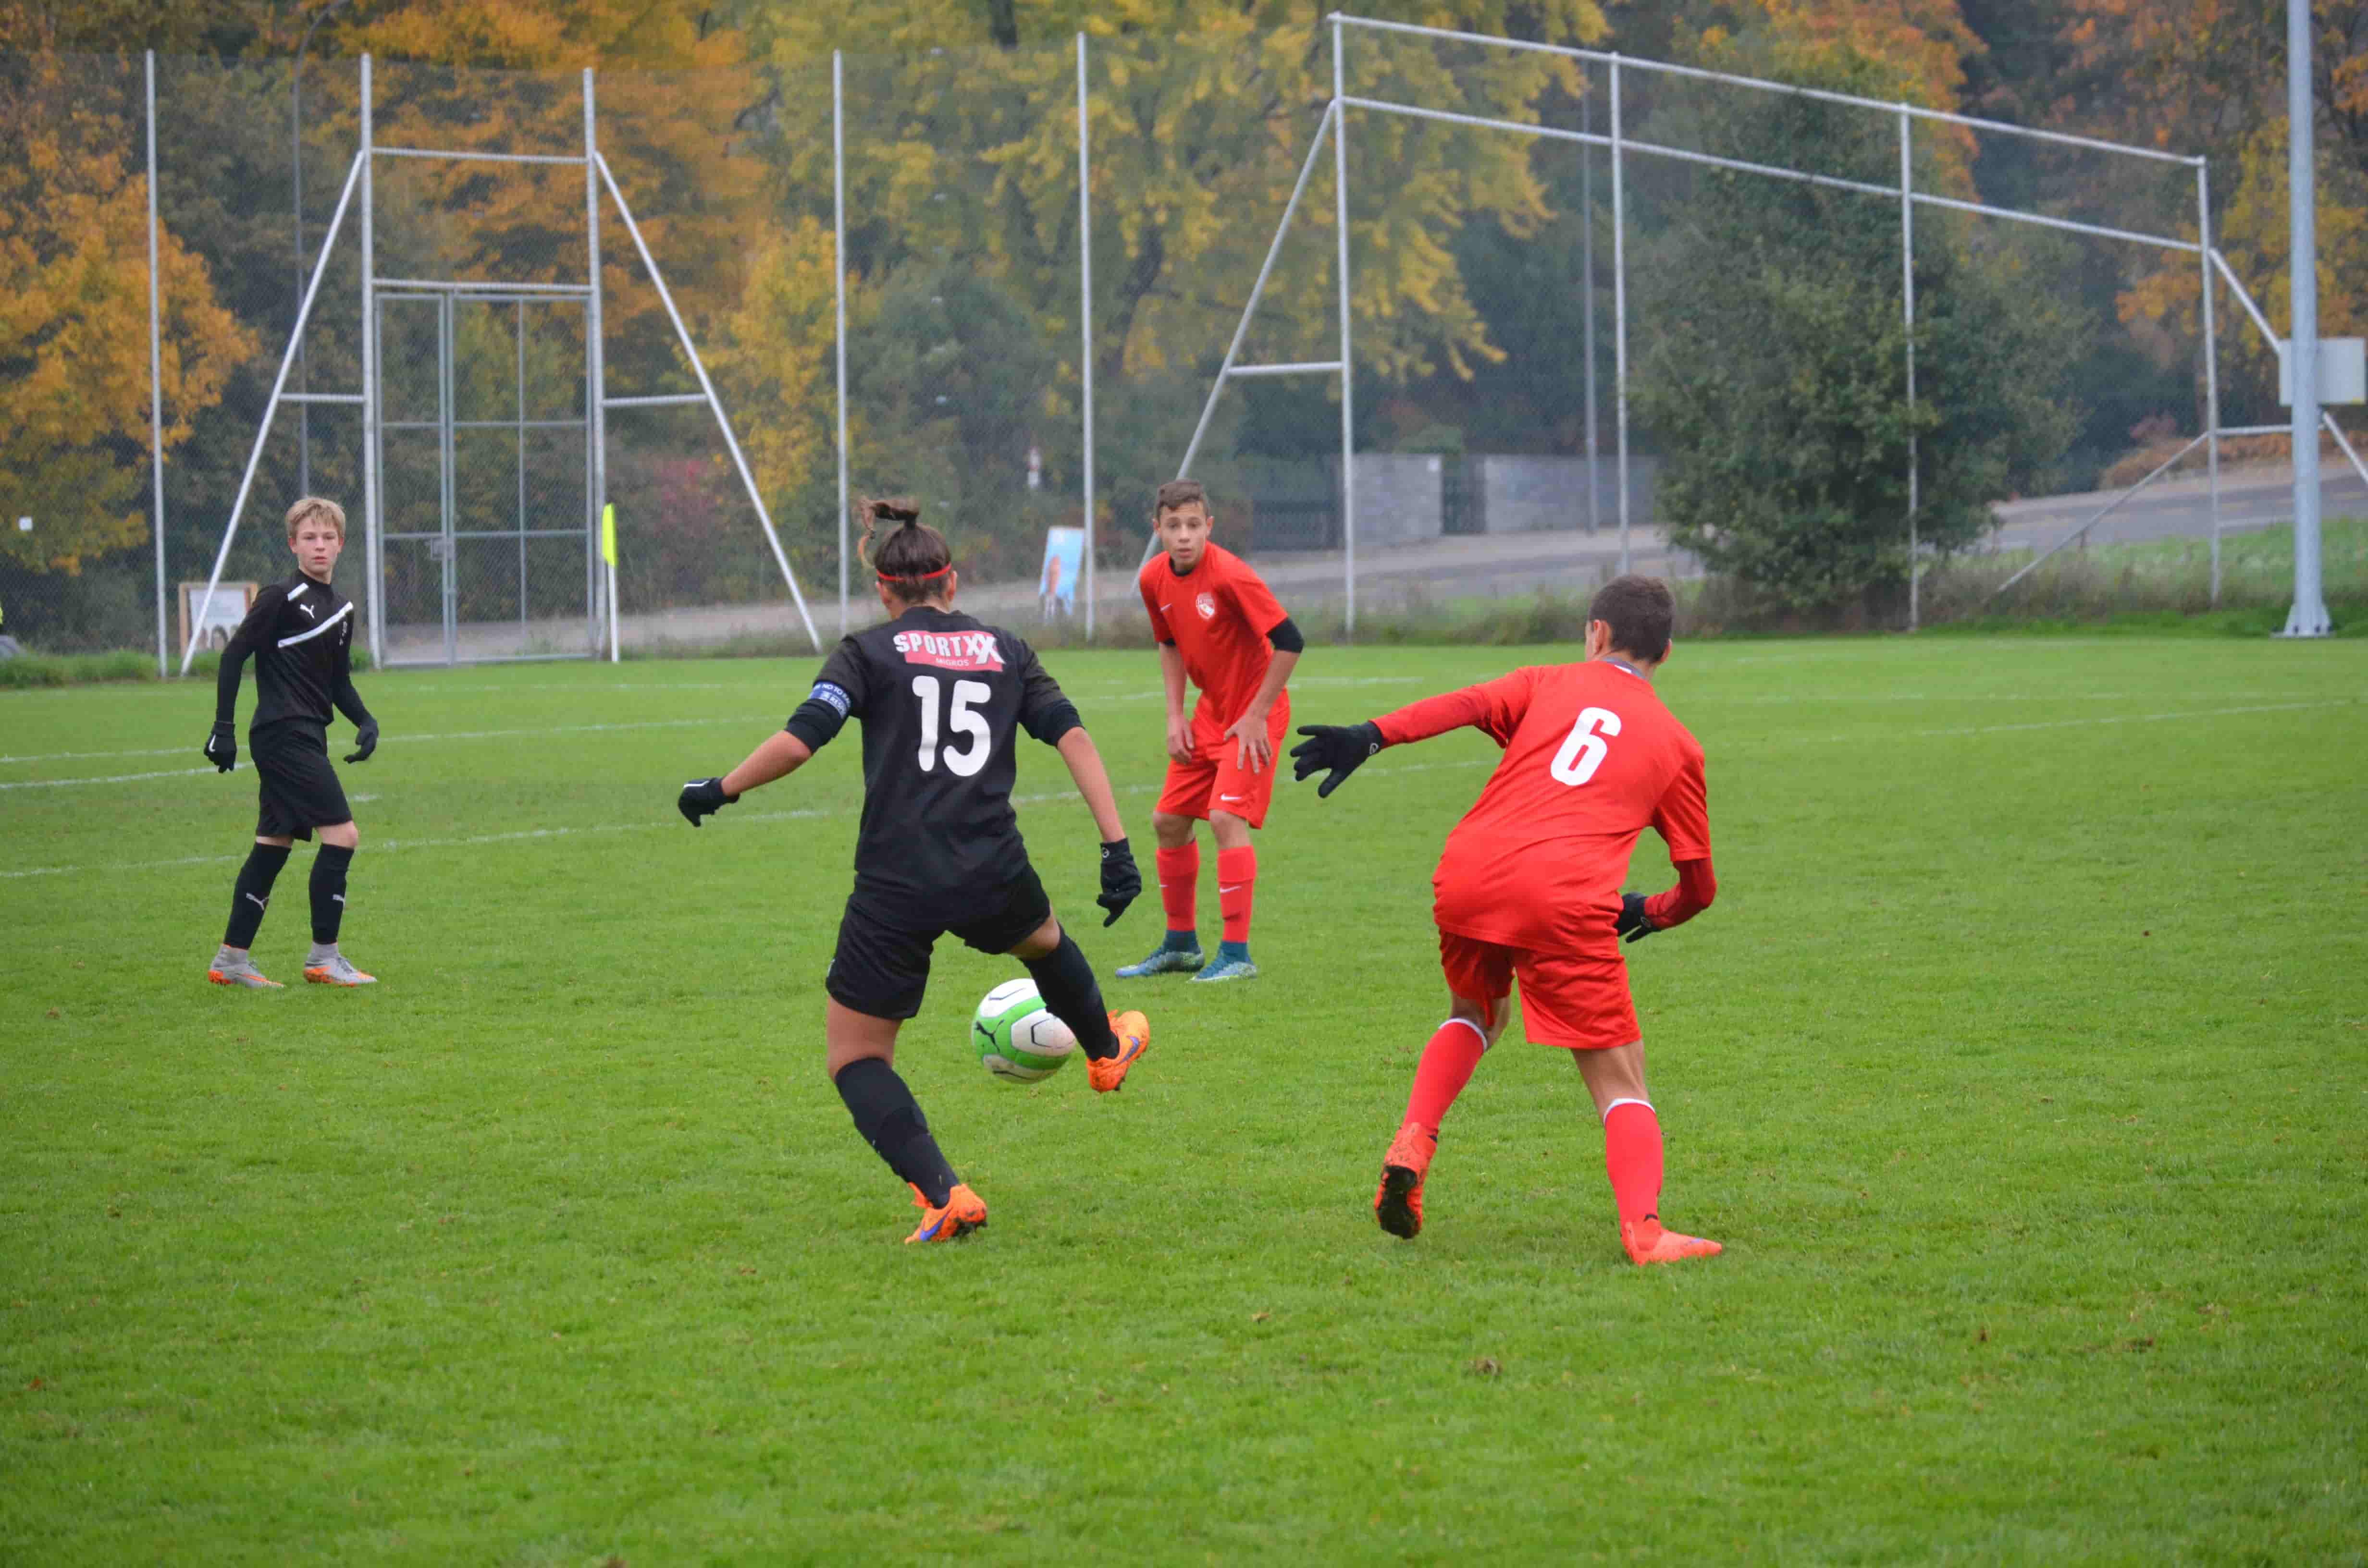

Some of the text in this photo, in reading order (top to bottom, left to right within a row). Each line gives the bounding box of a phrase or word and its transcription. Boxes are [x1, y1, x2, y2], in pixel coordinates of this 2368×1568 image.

[893, 633, 1006, 664] SPORTXX
[912, 675, 991, 776] 15
[1551, 707, 1621, 786] 6
